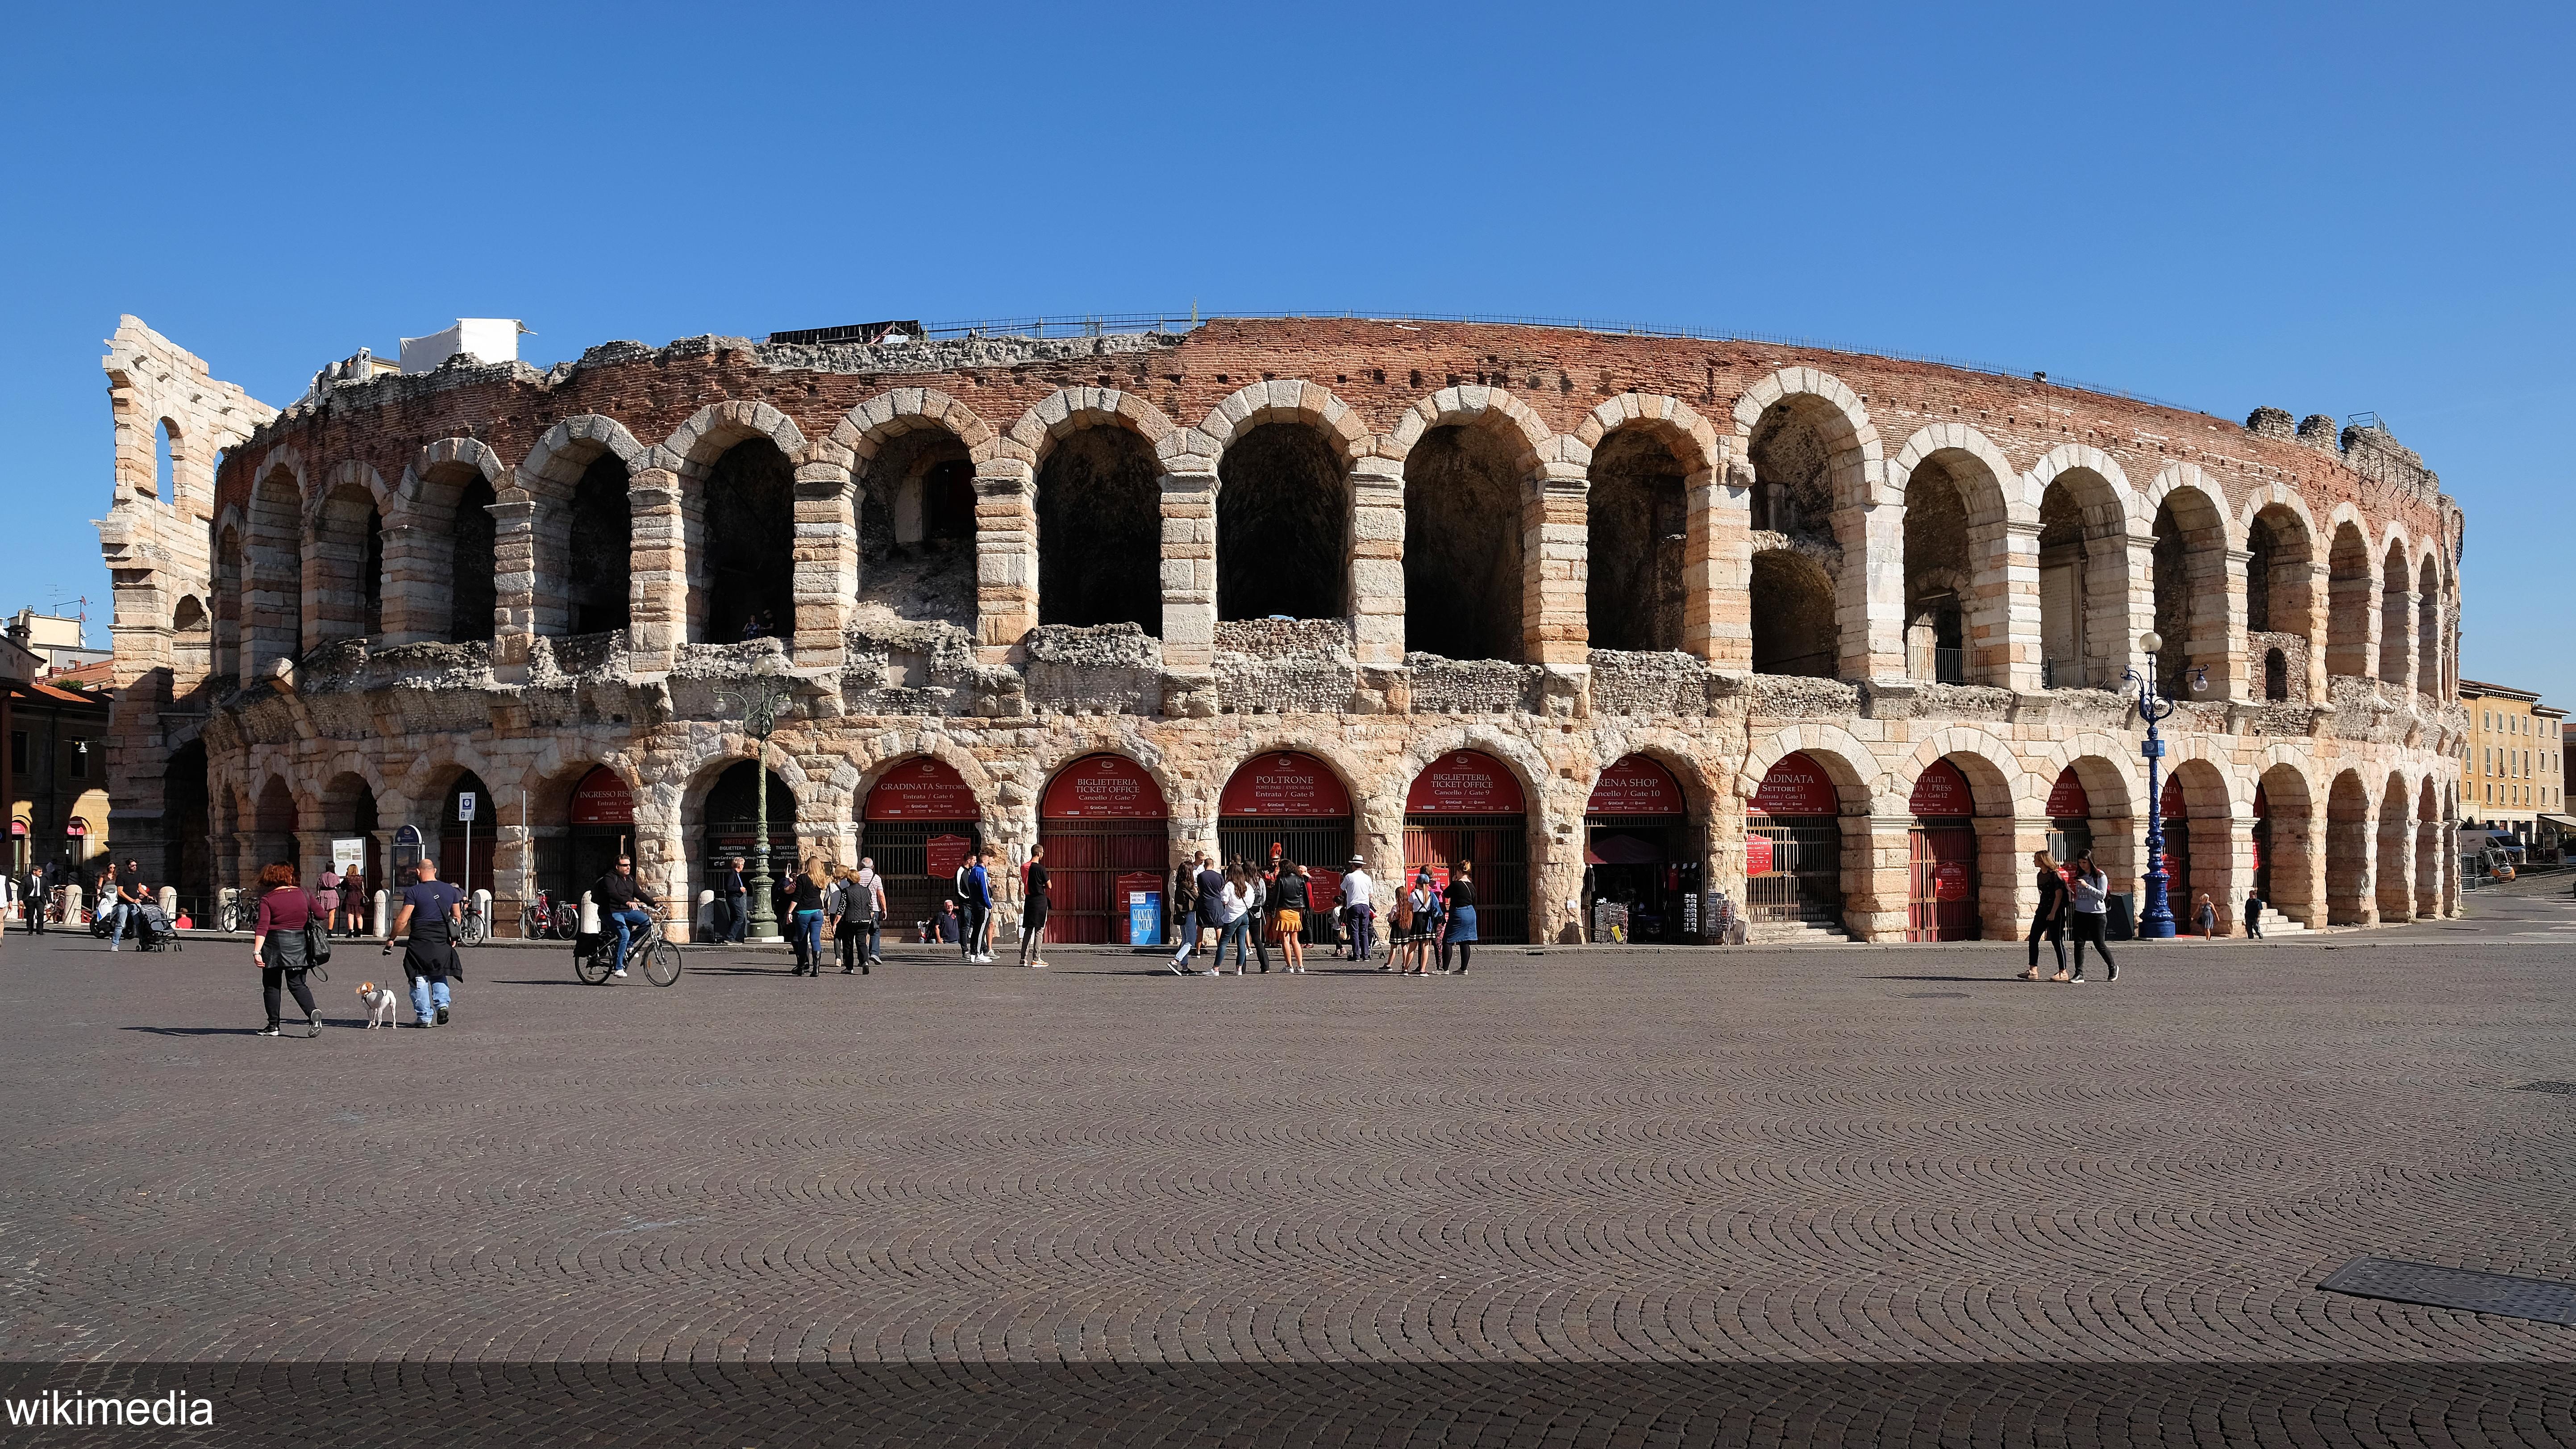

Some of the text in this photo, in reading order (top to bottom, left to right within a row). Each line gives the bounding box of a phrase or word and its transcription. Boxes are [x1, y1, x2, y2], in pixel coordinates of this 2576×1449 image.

[1596, 779, 1658, 787] RENA SHOP
[1762, 774, 1814, 783] ADINATA
[1132, 909, 1159, 920] MAMMA
